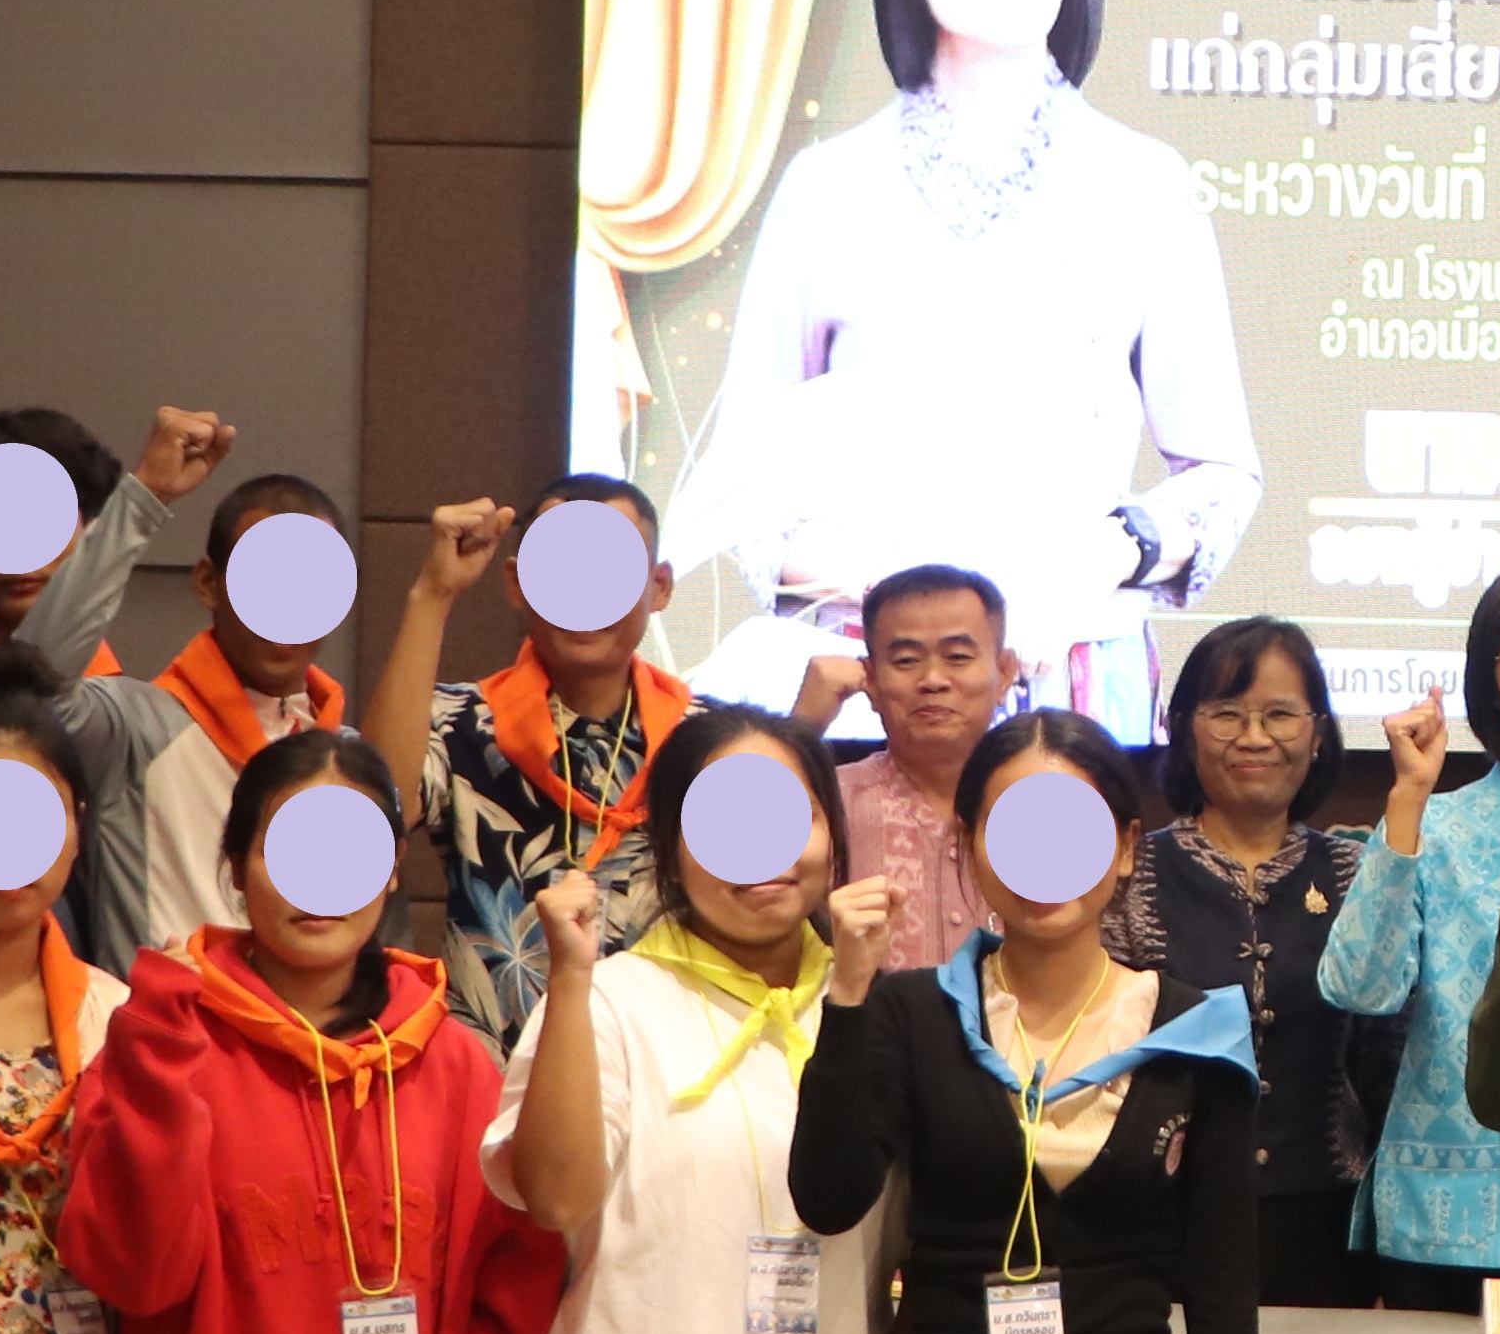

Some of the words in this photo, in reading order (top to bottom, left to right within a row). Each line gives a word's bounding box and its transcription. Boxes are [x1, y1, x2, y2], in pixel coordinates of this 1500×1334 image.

[1188, 125, 1487, 223] ระหว่างวันที่
